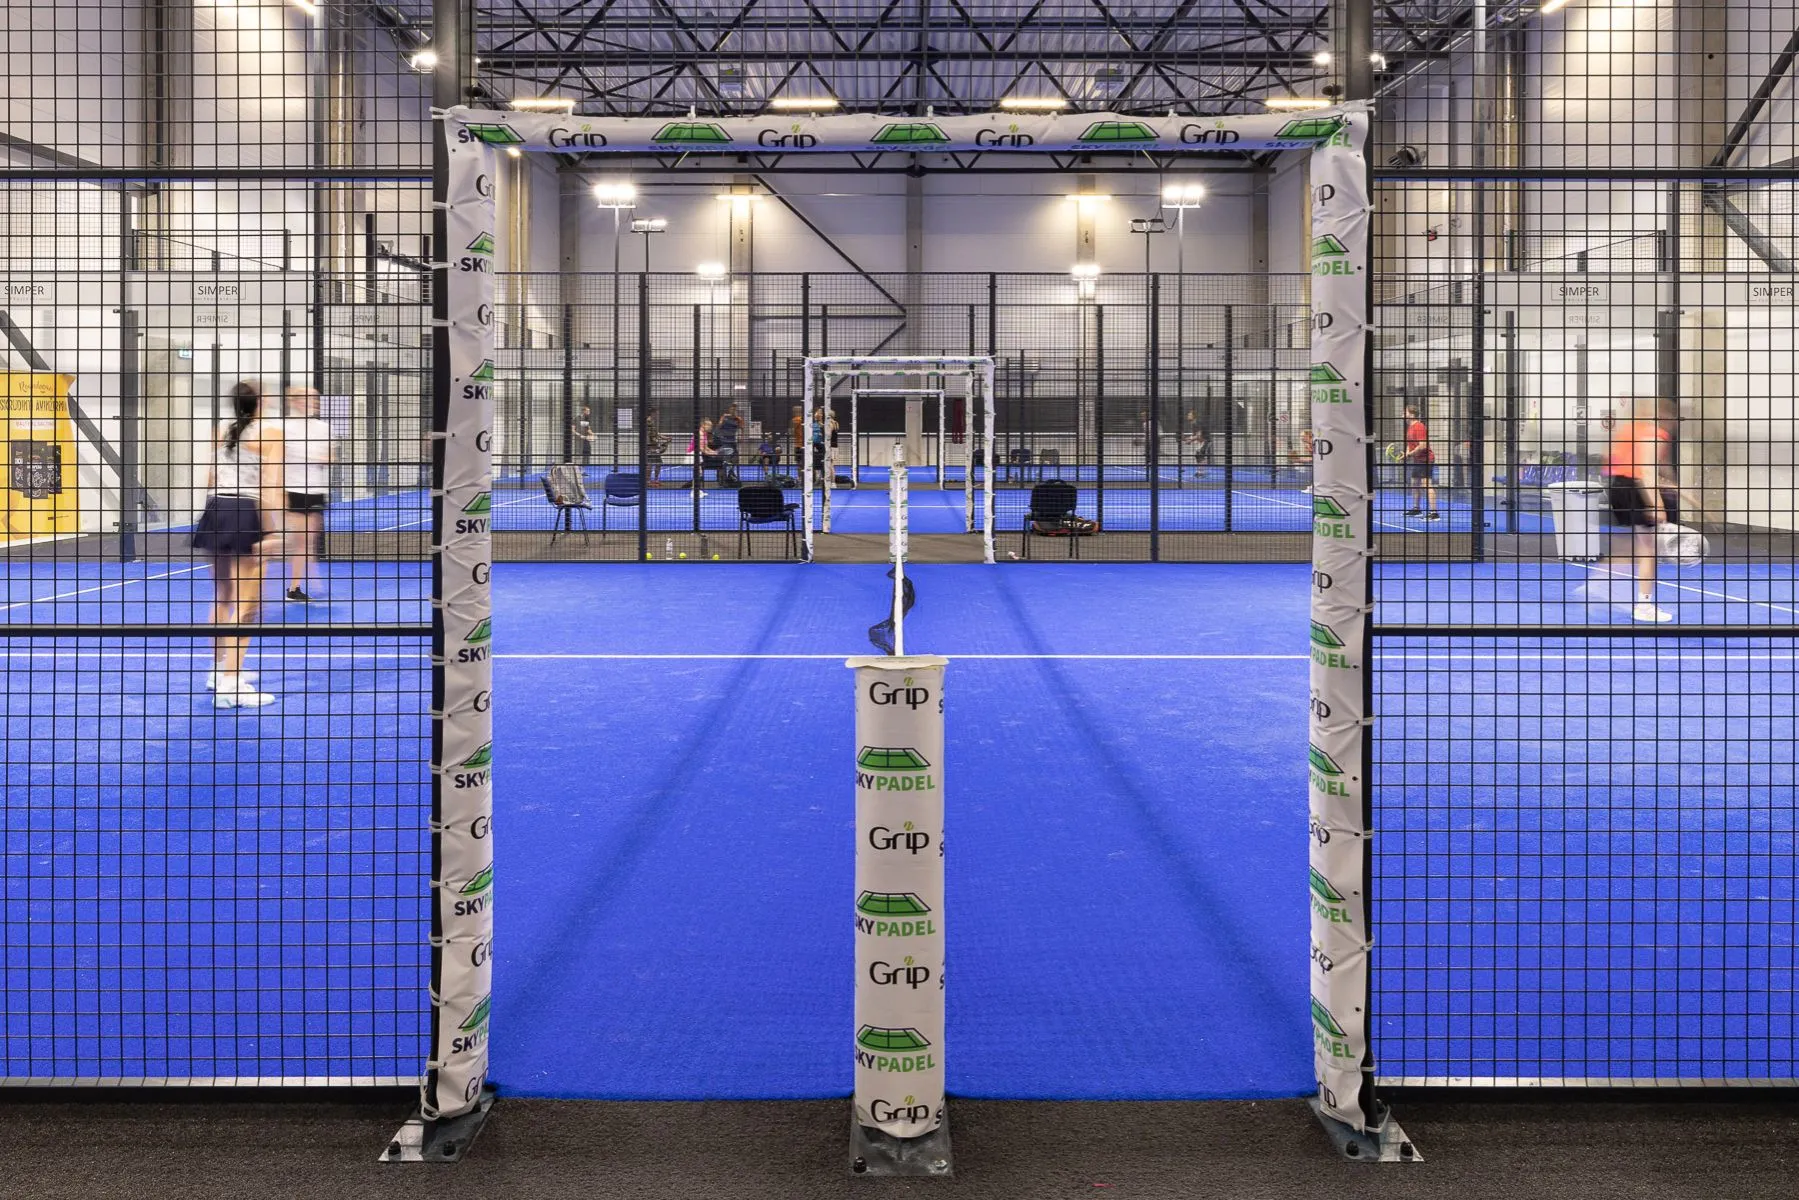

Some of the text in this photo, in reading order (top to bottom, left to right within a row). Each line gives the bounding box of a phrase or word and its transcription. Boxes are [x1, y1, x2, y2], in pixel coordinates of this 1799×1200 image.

[549, 124, 608, 148] Grip
[758, 123, 817, 149] Grip
[975, 123, 1034, 148] Grip
[1180, 120, 1240, 146] Grip
[4, 285, 45, 296] SIMPER
[198, 285, 239, 296] SIMPER
[1559, 286, 1600, 297] SIMPER
[1753, 287, 1794, 297] SIMPER
[869, 677, 930, 711] Grip
[869, 821, 930, 855] Grip
[869, 955, 931, 990] Grip
[871, 1095, 930, 1124] Grip
